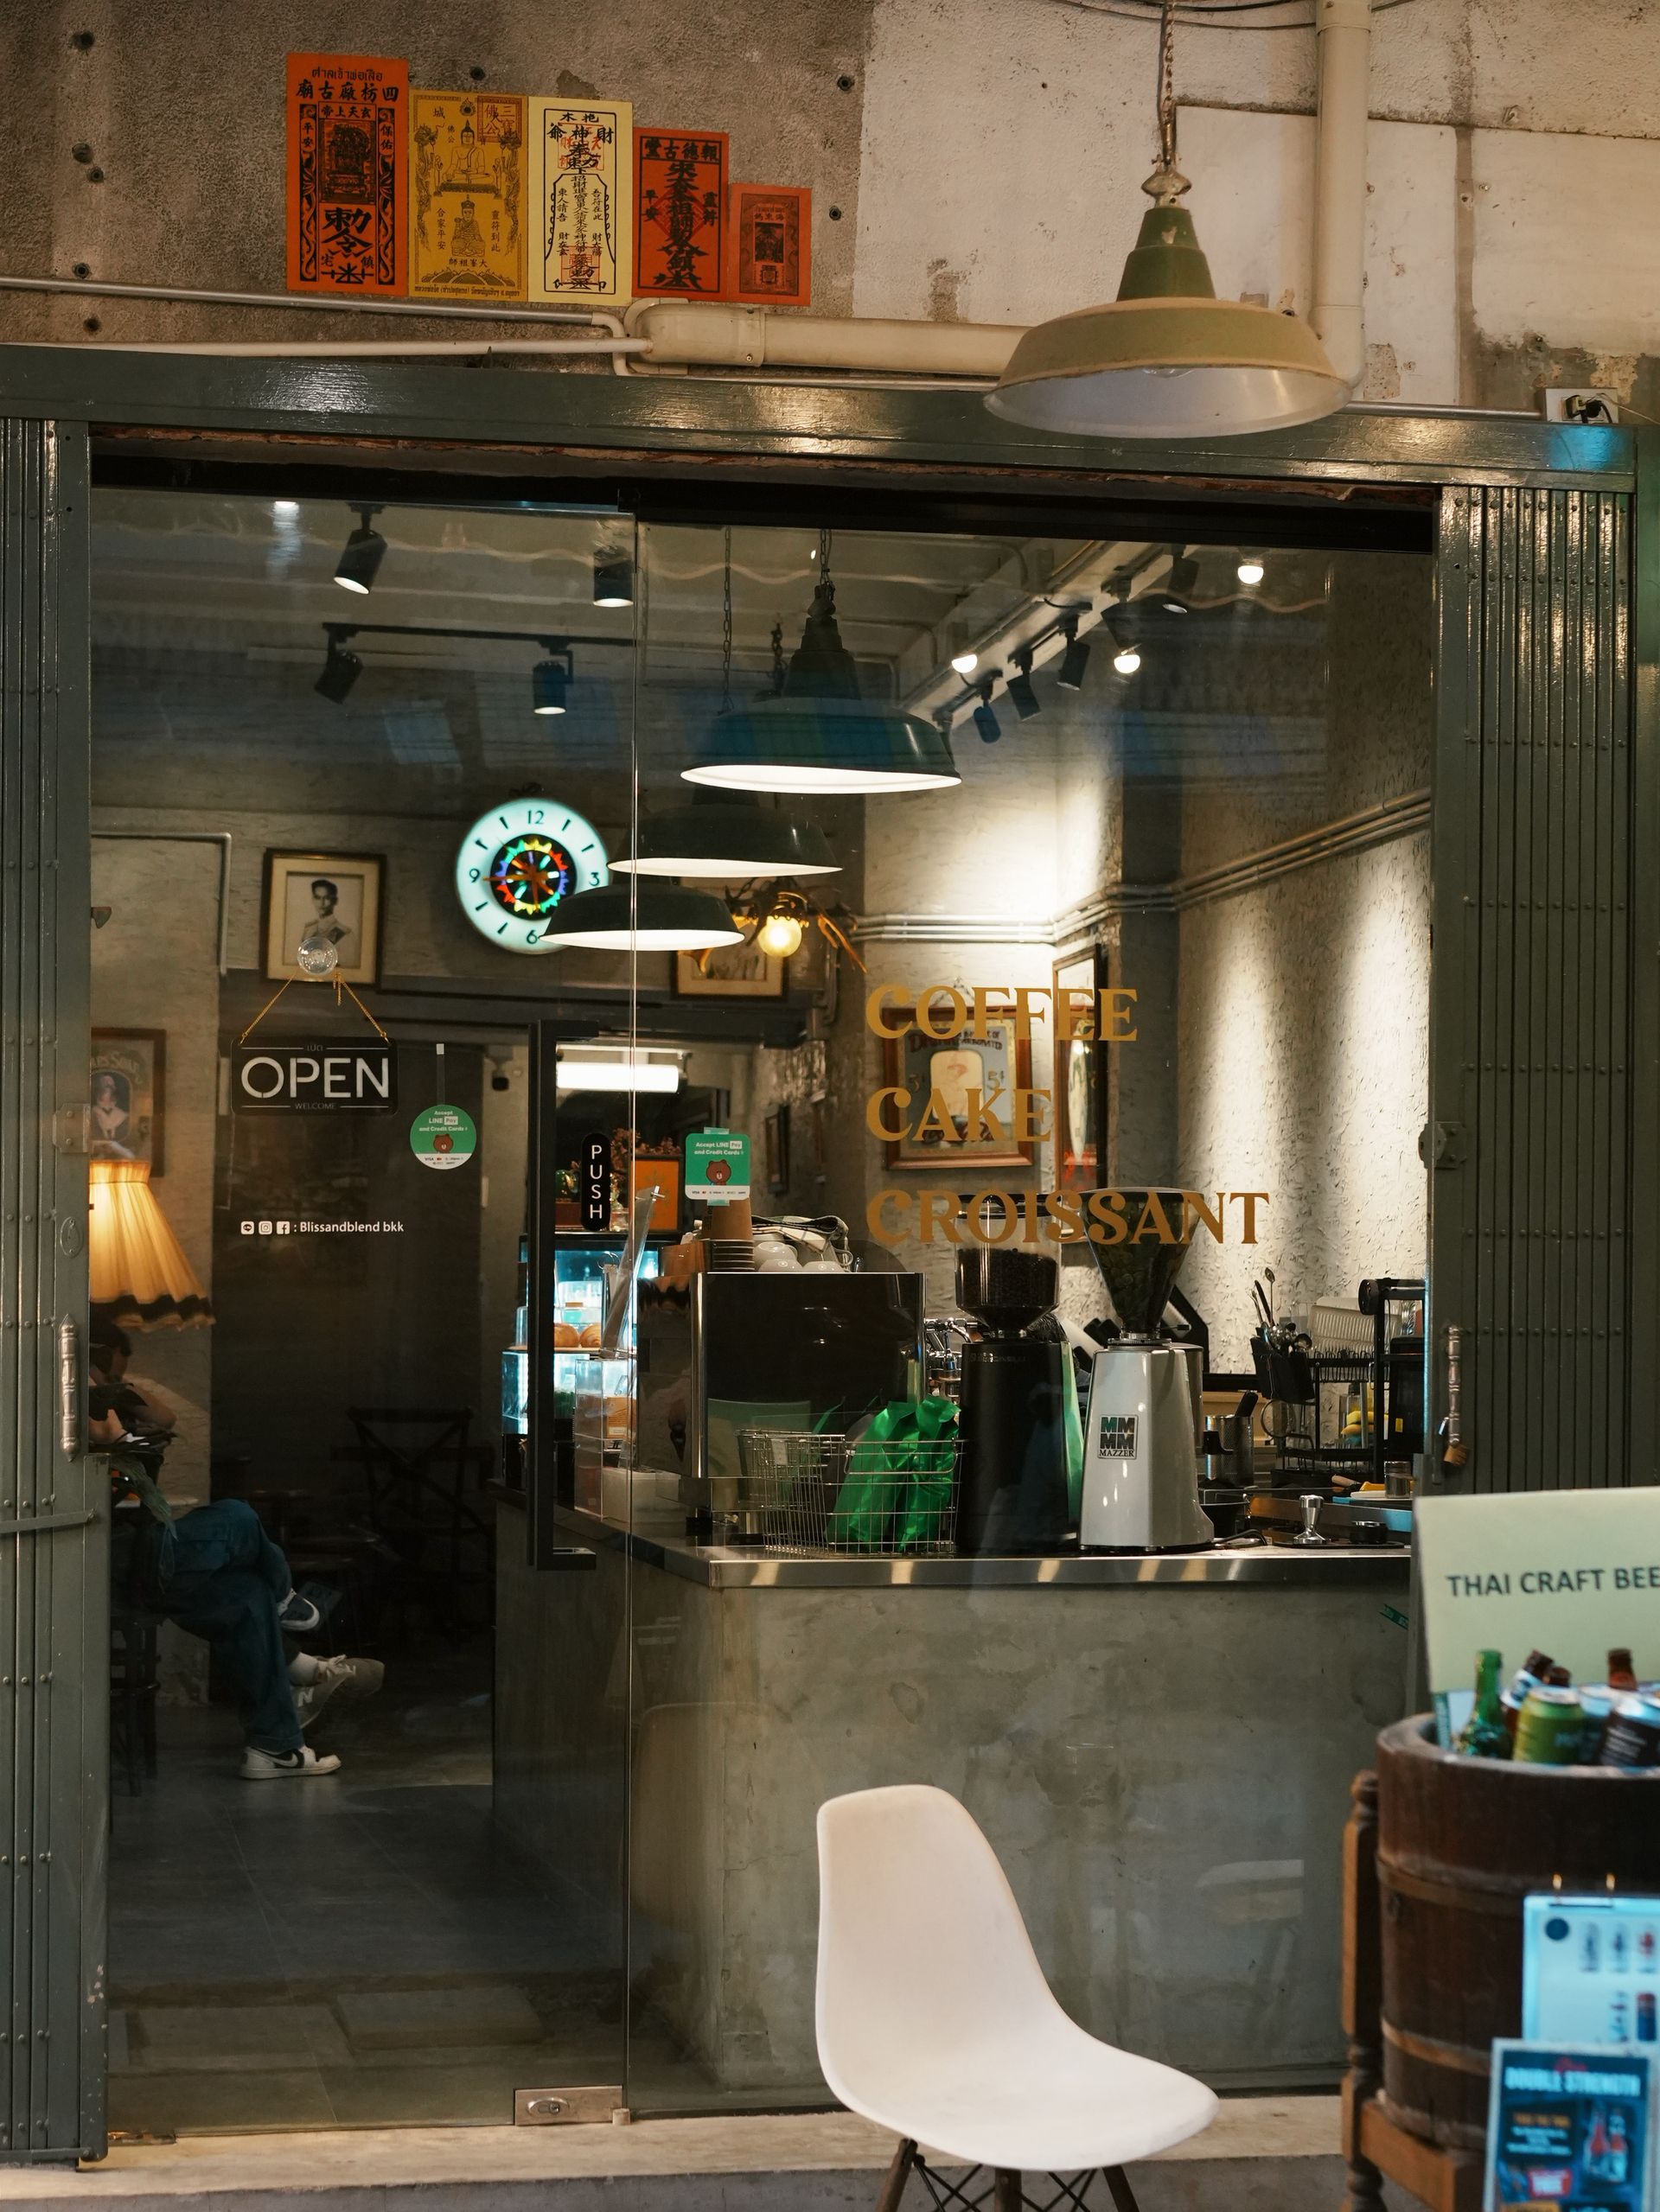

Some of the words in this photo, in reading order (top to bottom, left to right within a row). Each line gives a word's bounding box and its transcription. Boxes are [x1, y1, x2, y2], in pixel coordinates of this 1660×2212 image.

[527, 810, 545, 825] 12
[469, 868, 481, 883] 9
[588, 871, 600, 887] 3
[526, 929, 539, 945] 6
[865, 984, 1139, 1042] COFFEE
[240, 1056, 390, 1099] OPEN
[294, 1102, 336, 1111] WELCOME
[865, 1086, 1052, 1143] CAKE
[589, 1144, 603, 1221] PUSH
[865, 1188, 1270, 1245] CROISSANT
[299, 1220, 380, 1233] Blissandblend
[383, 1220, 405, 1233] bkk
[1099, 1449, 1135, 1457] MAZZER
[1446, 1572, 1511, 1597] THAI
[1520, 1569, 1605, 1595] CRAFT
